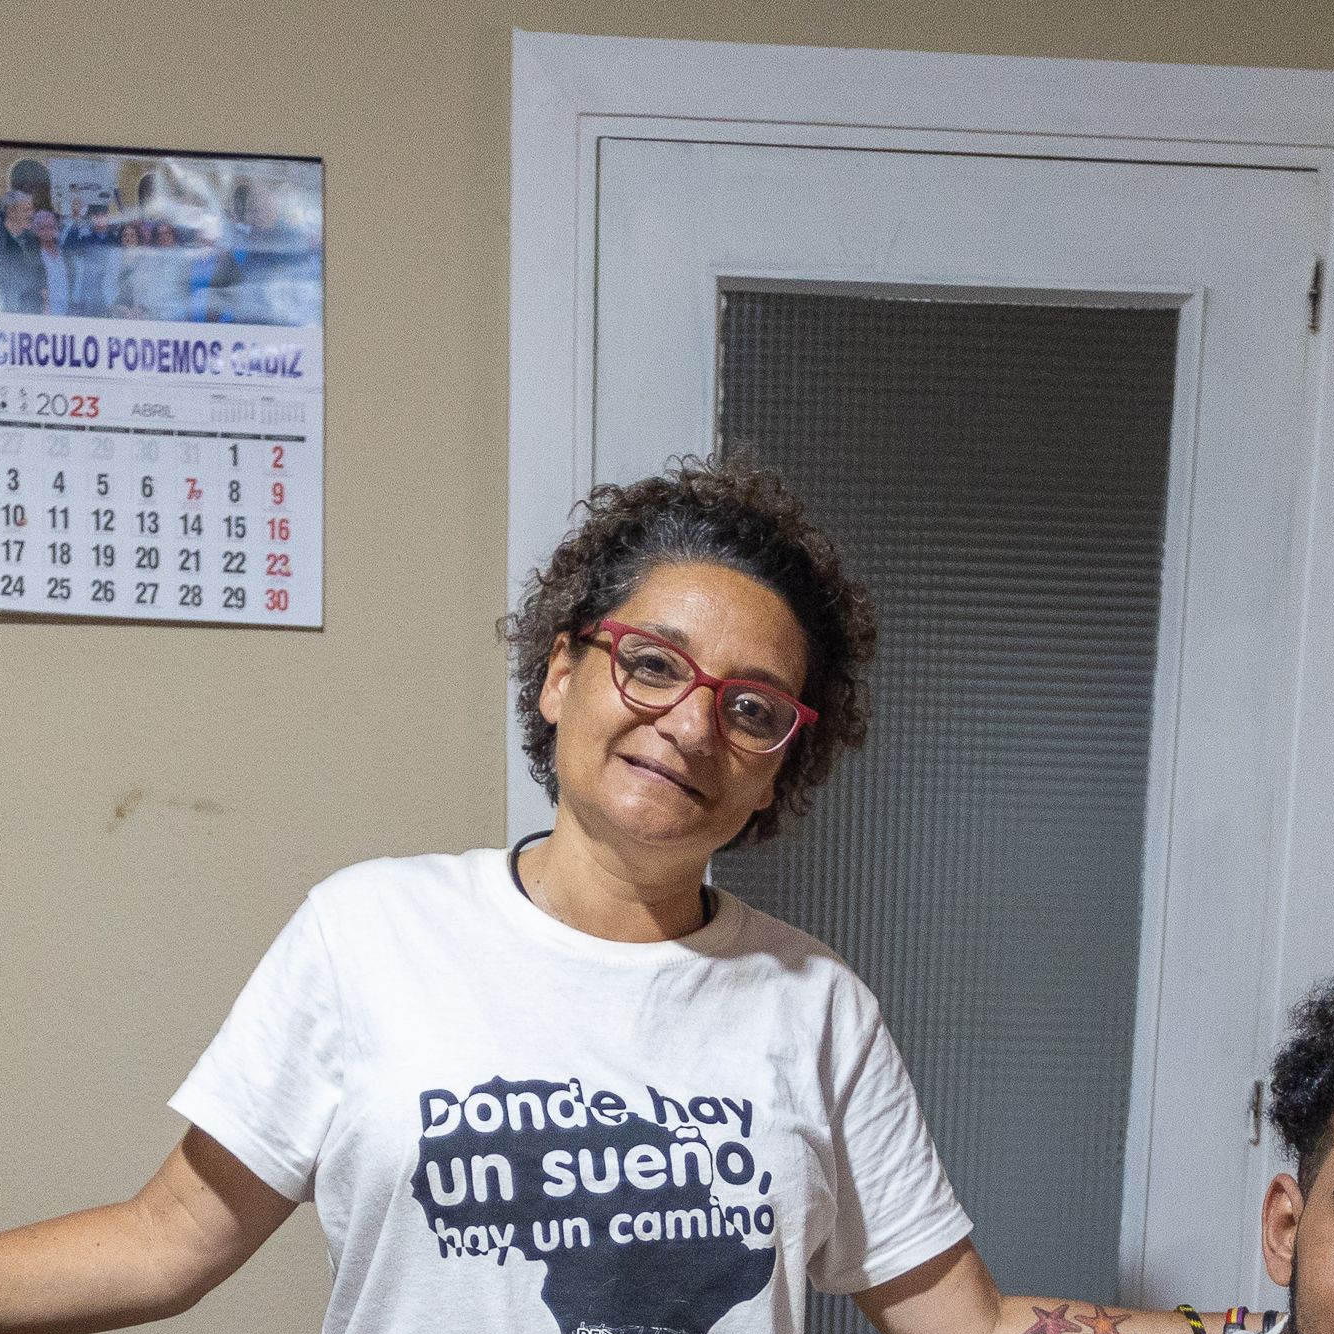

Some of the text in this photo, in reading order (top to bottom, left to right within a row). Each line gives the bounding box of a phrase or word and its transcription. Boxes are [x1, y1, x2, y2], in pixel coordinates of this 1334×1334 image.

[107, 337, 223, 374] PODEMOS
[37, 392, 176, 419] 2023 ABRIL
[228, 444, 239, 466] 1
[272, 446, 284, 469] 2
[6, 468, 19, 491] 3
[52, 471, 65, 493] 4
[97, 473, 109, 495] 5
[141, 475, 153, 498] 6
[228, 480, 240, 503] 8
[272, 482, 284, 505] 9
[1, 503, 290, 540] 10 11 12 13 14 15 16
[1, 540, 290, 576] 17 18 19 20 21 22 23
[1, 575, 289, 611] 24 25 26 27 28 29 30
[420, 1078, 753, 1138] Donde hay
[426, 1126, 772, 1206] un sueño,
[434, 1196, 774, 1266] hay un camino
